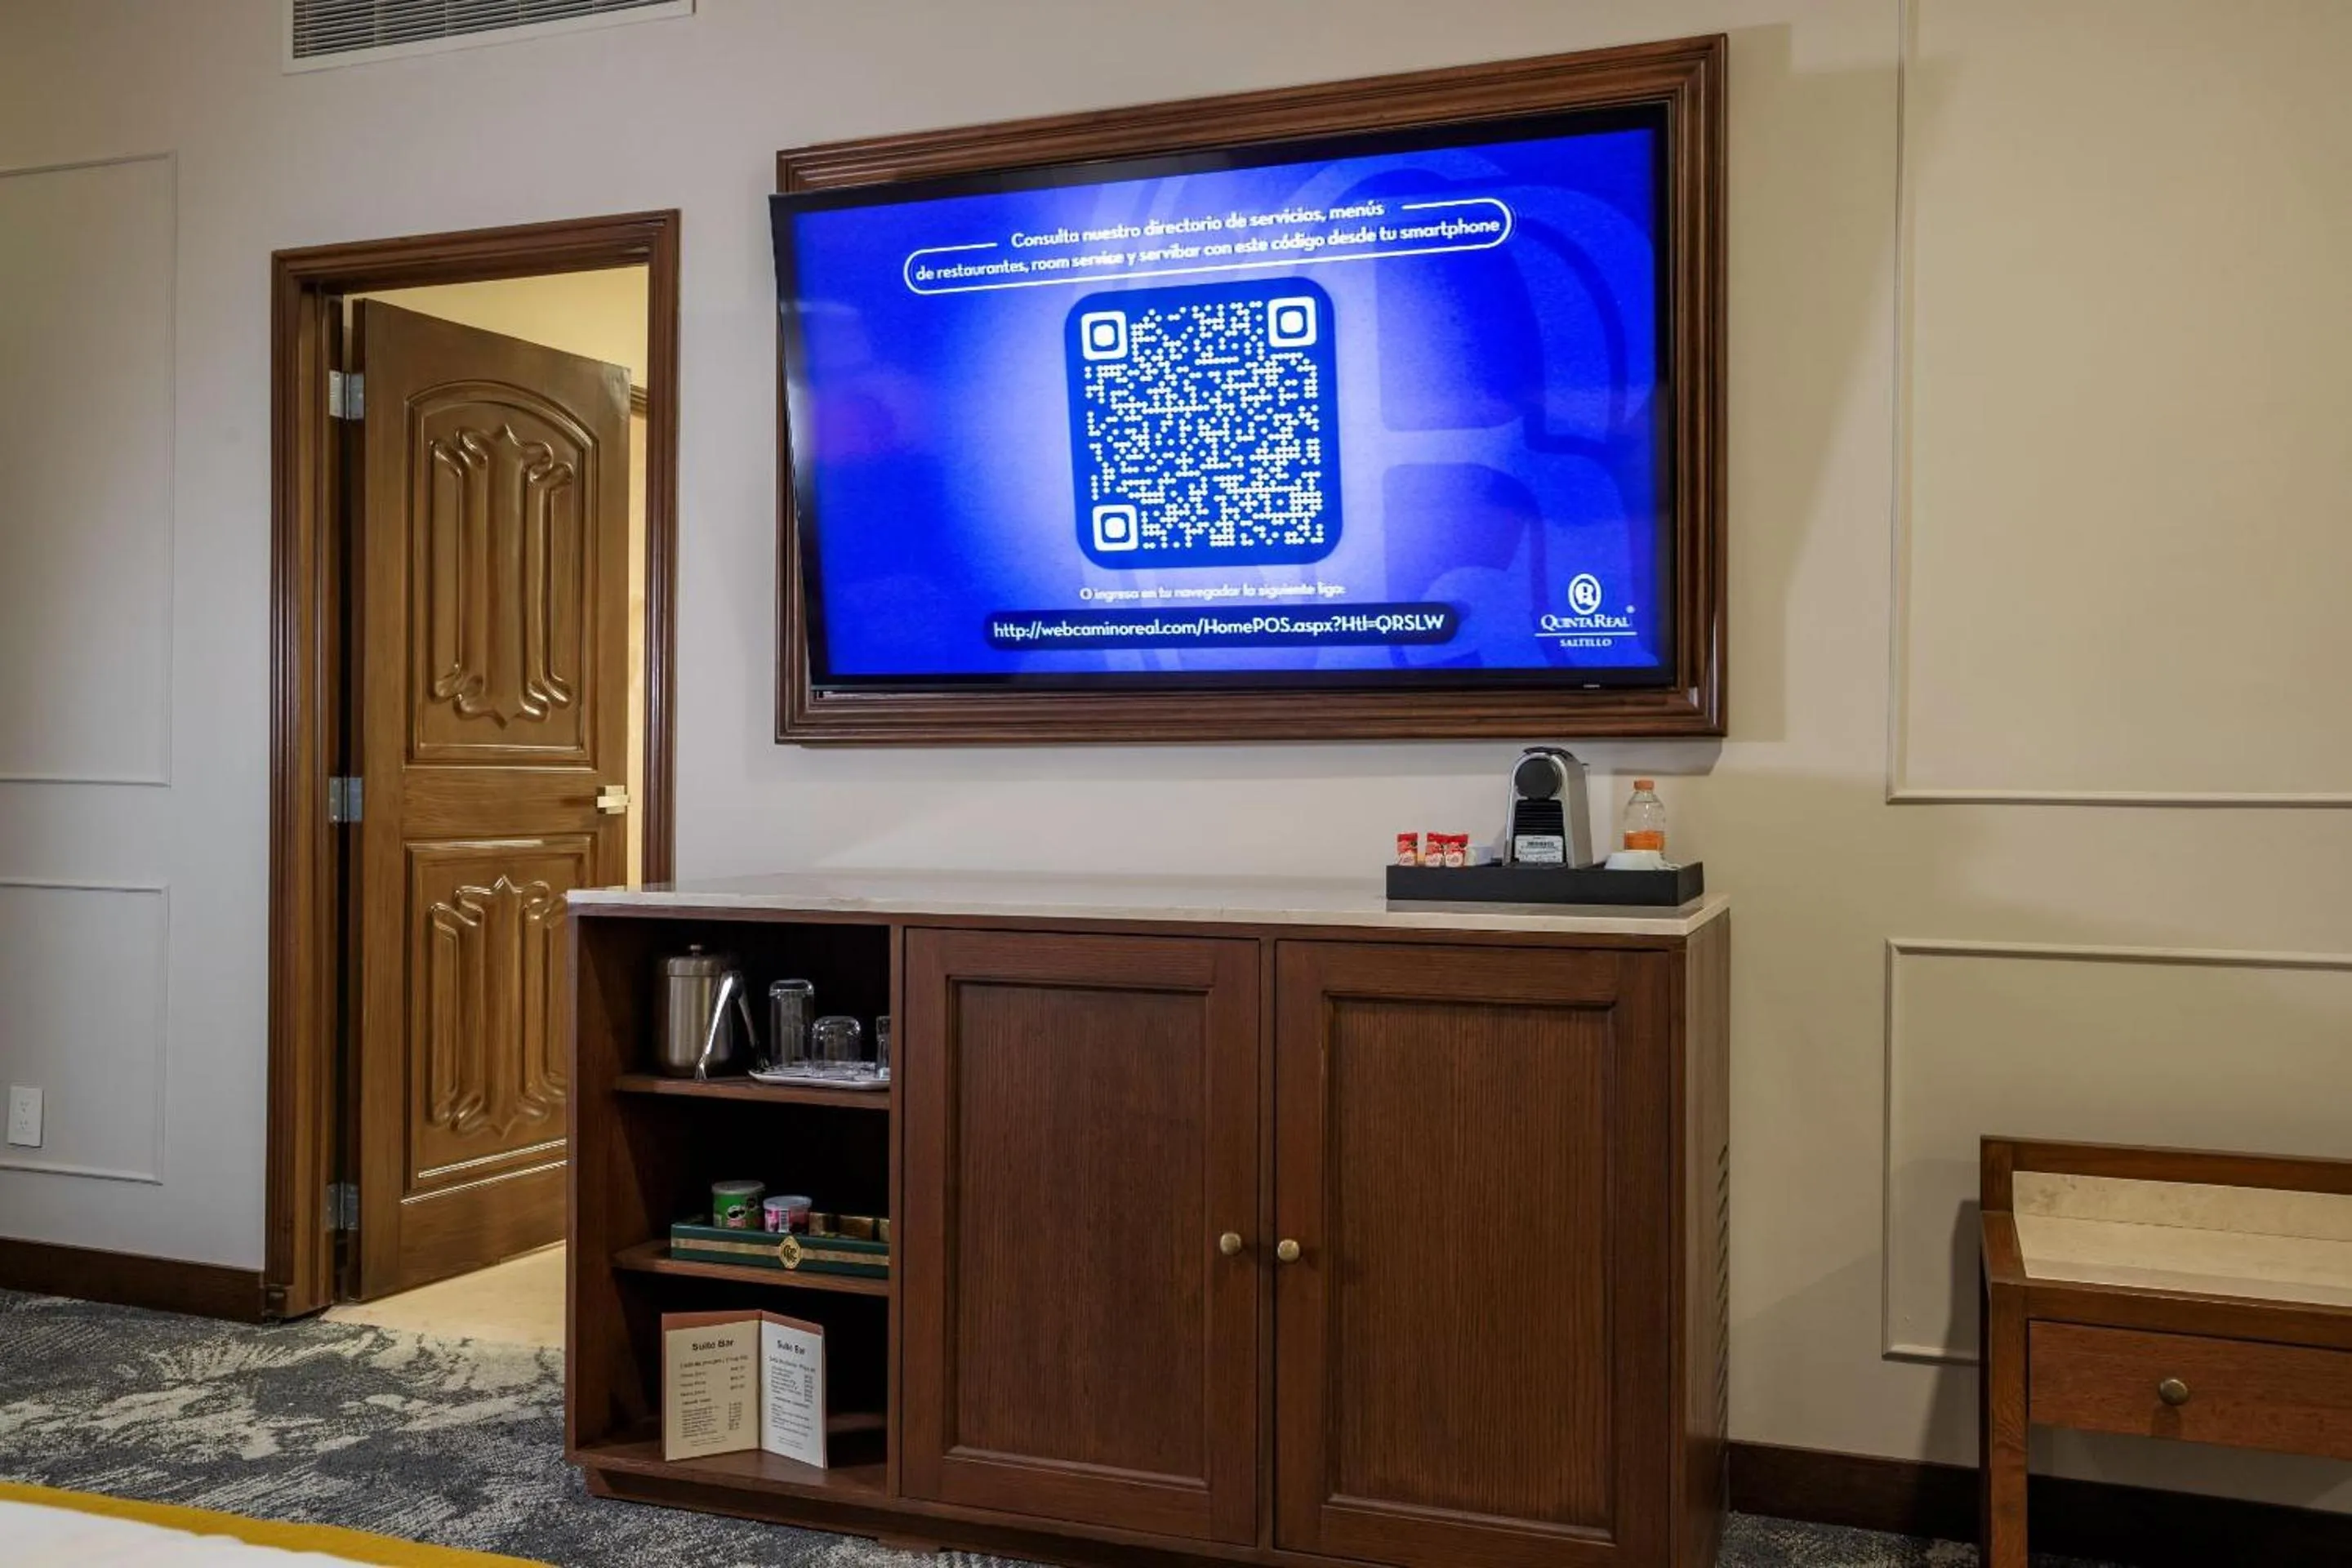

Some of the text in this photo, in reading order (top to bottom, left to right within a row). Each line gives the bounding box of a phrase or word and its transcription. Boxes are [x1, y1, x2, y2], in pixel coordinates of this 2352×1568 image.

[1011, 201, 1384, 247] Consulta nuestro directorio de servicios, menús
[915, 217, 1500, 281] de restaurantes, room service y servibar con este código desde tu smartphone
[1080, 587, 1094, 600] O
[1141, 590, 1157, 599] en
[1159, 586, 1173, 599] tu
[1174, 583, 1241, 601] navegador
[1242, 582, 1256, 596] la
[1258, 583, 1316, 599] siguiente
[993, 614, 1445, 641] http://webcaminoreal.com/HomePOS.aspx?Htl=QRSLW
